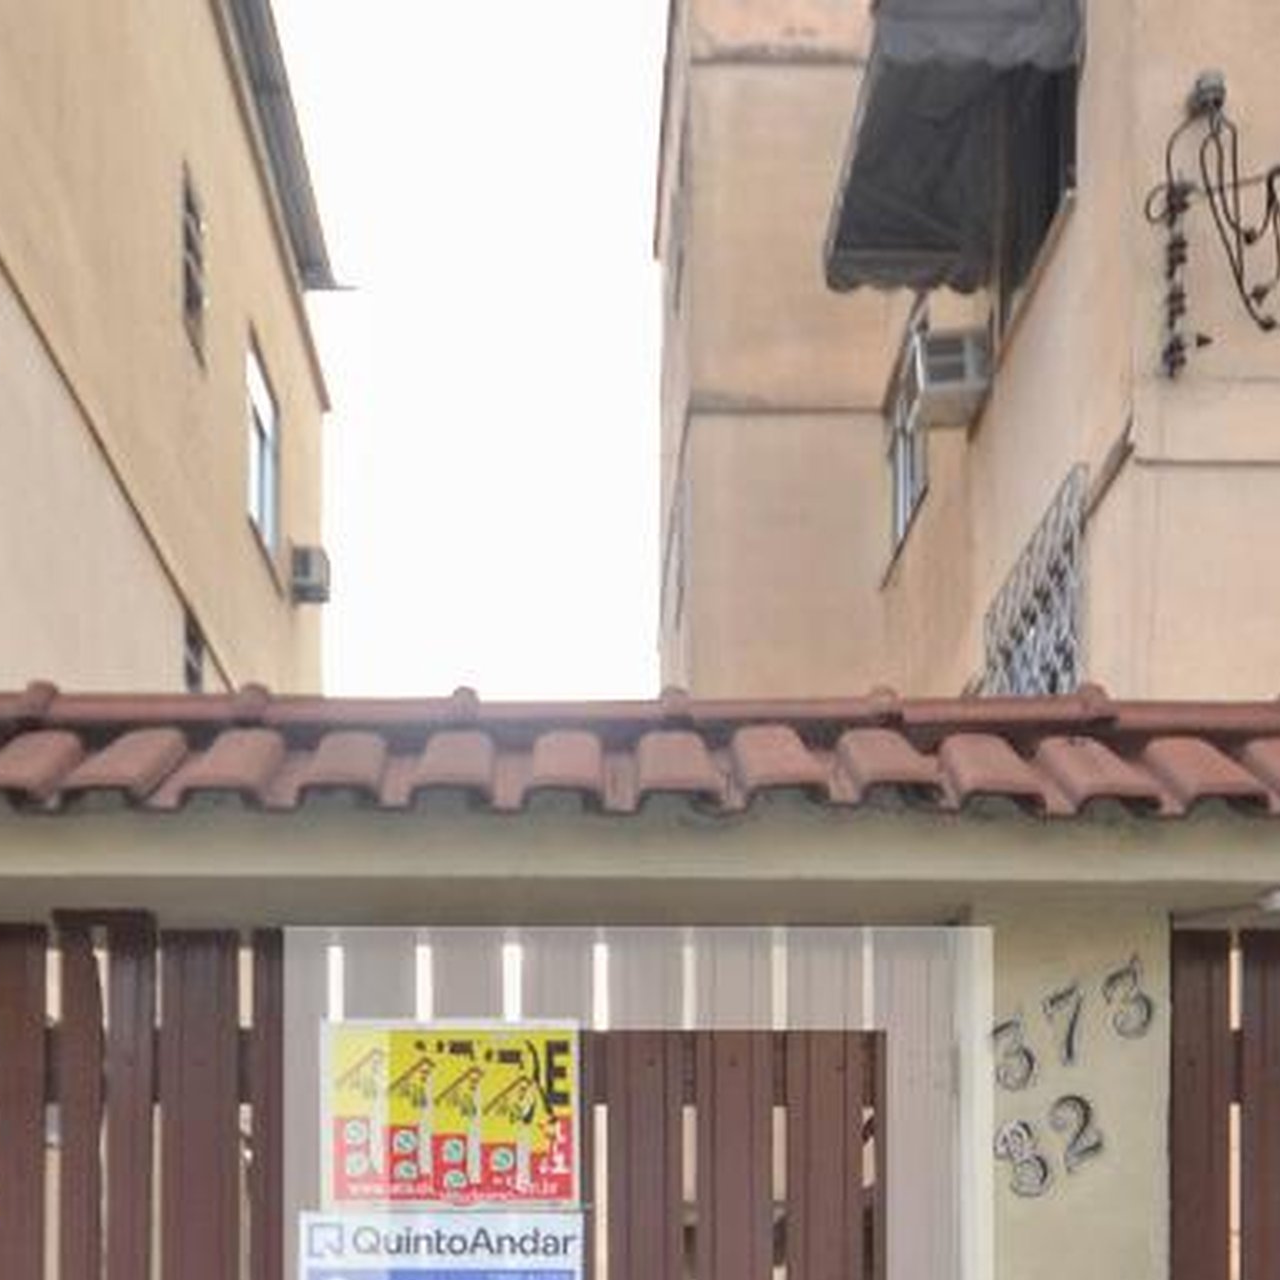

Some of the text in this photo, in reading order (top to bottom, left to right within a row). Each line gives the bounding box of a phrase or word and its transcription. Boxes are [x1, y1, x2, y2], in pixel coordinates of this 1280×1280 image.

[991, 952, 1153, 1092] 373
[993, 1094, 1103, 1198] 82
[352, 1226, 577, 1256] QuintoAndar
